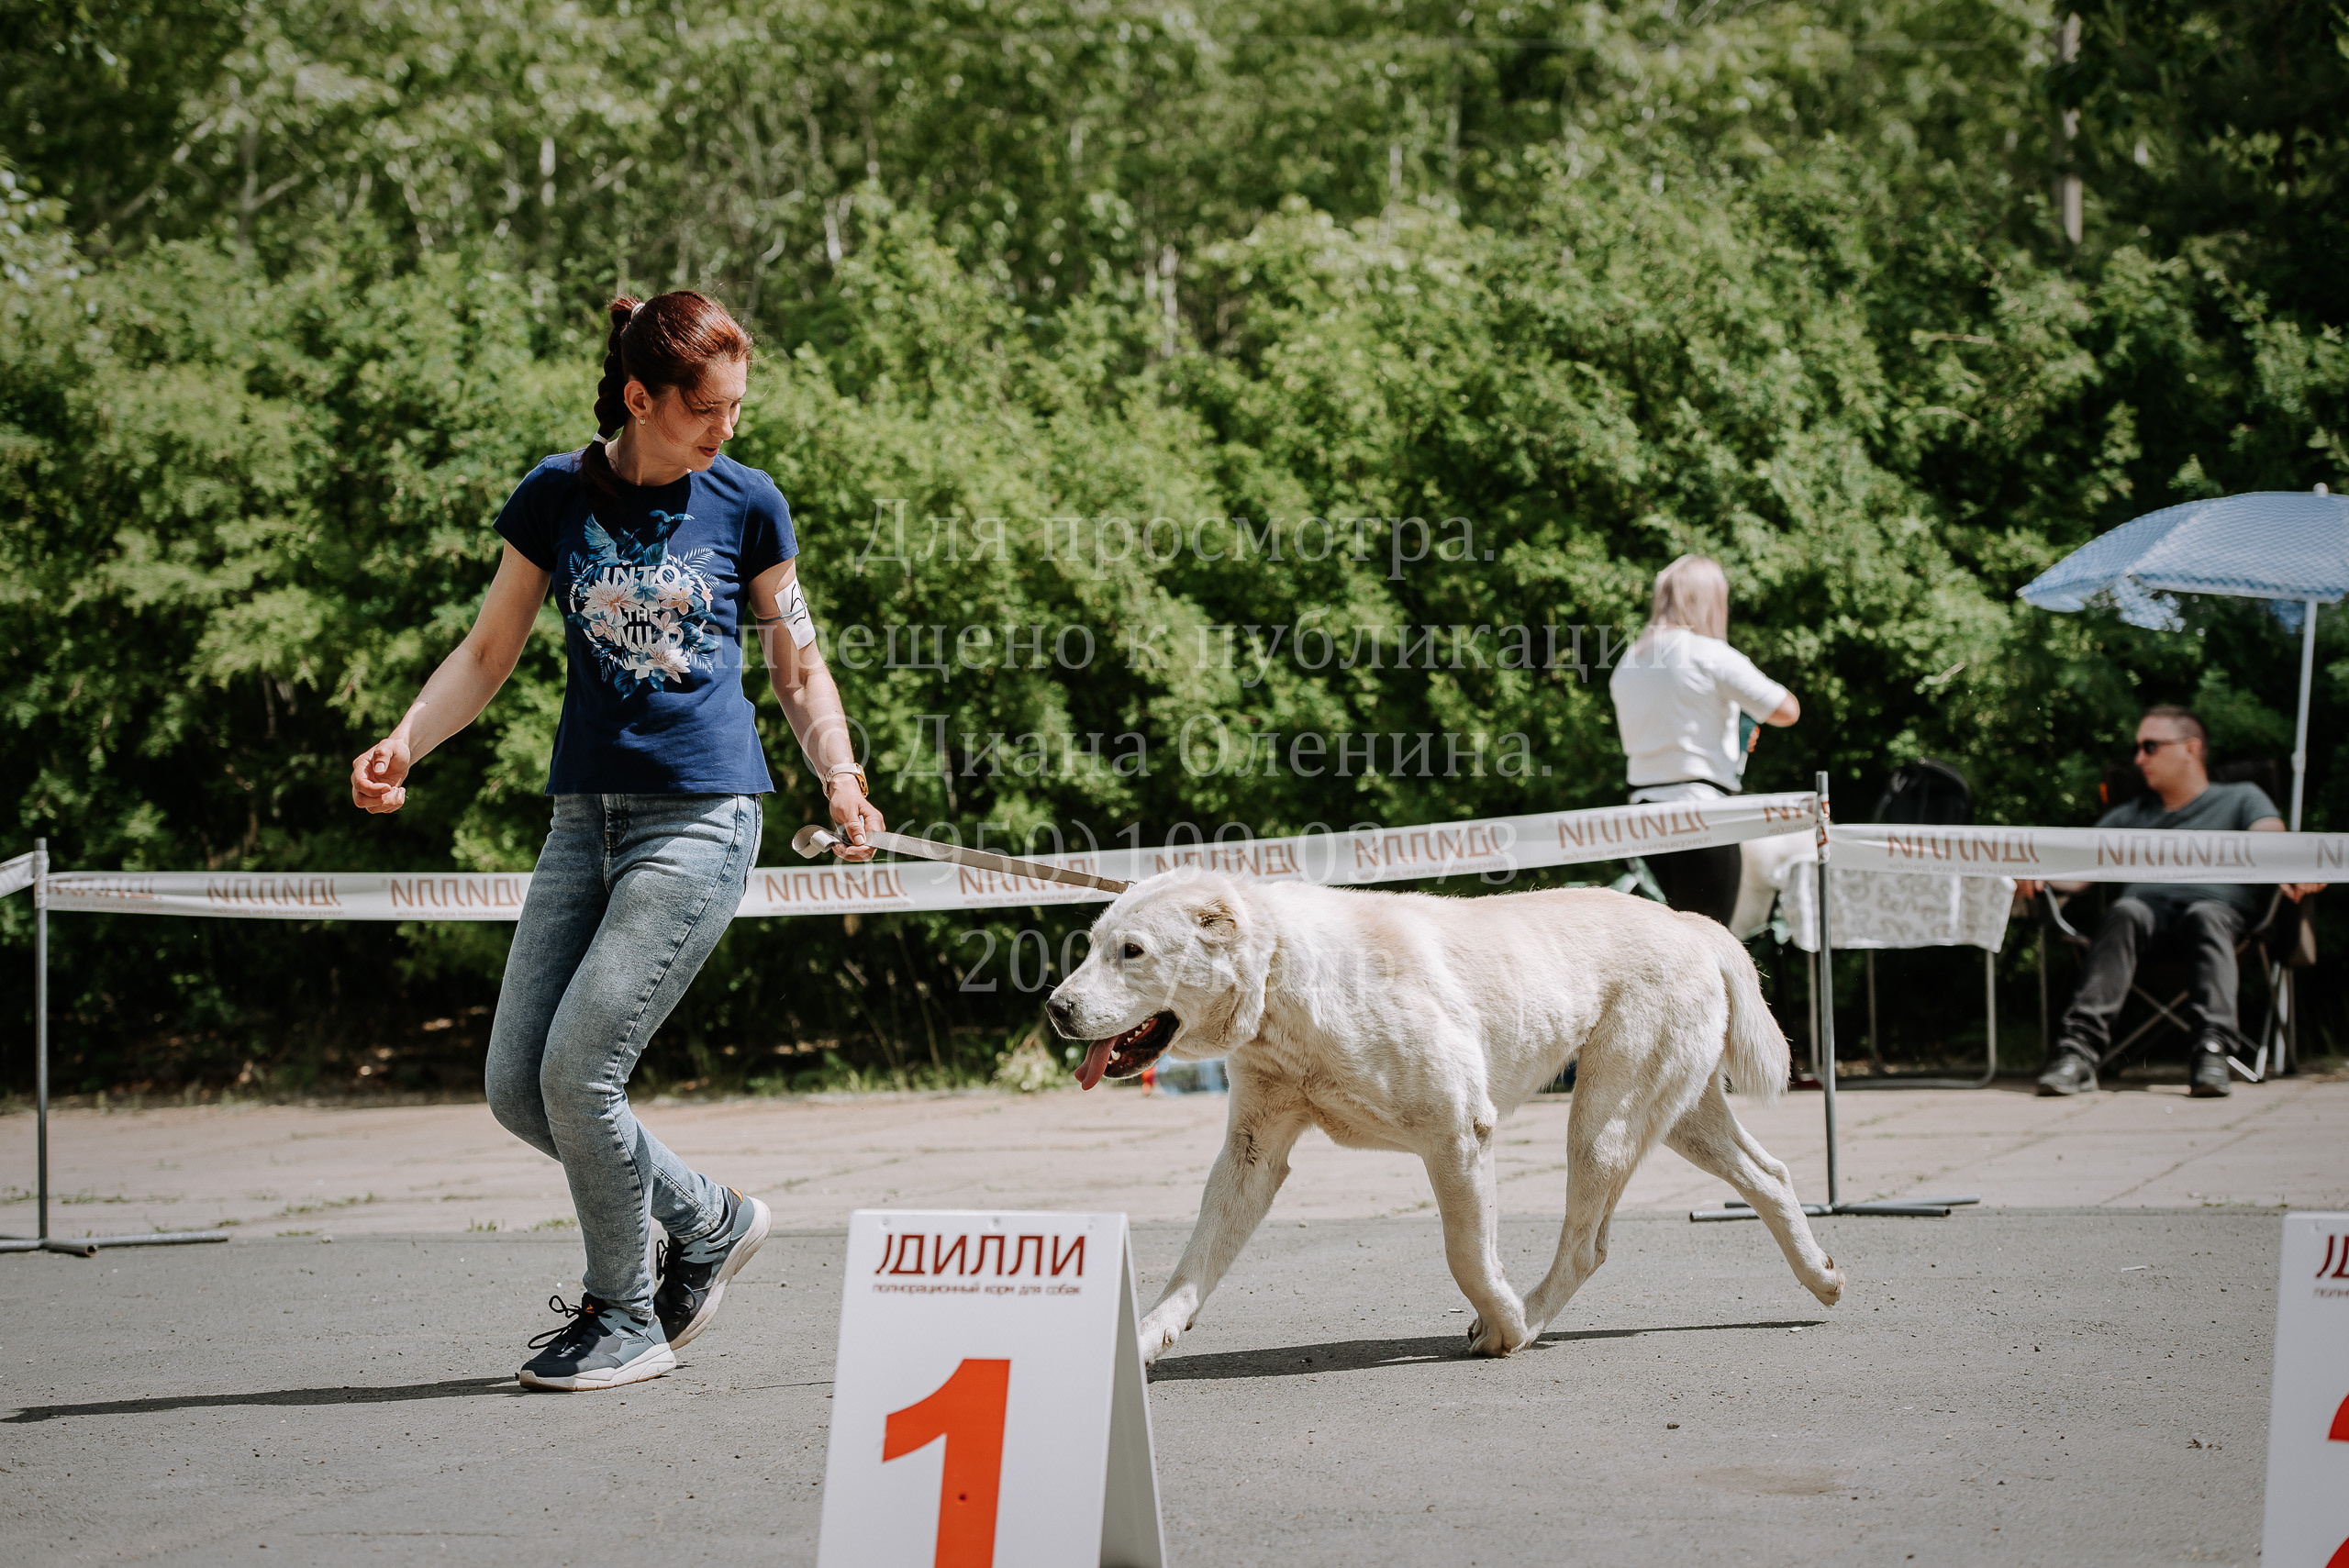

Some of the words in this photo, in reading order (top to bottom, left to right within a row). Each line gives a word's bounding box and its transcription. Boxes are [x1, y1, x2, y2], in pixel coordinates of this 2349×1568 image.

[603, 564, 683, 587] INTO
[624, 608, 659, 622] THE
[611, 625, 685, 649] WILD
[883, 1358, 1011, 1568] 1
